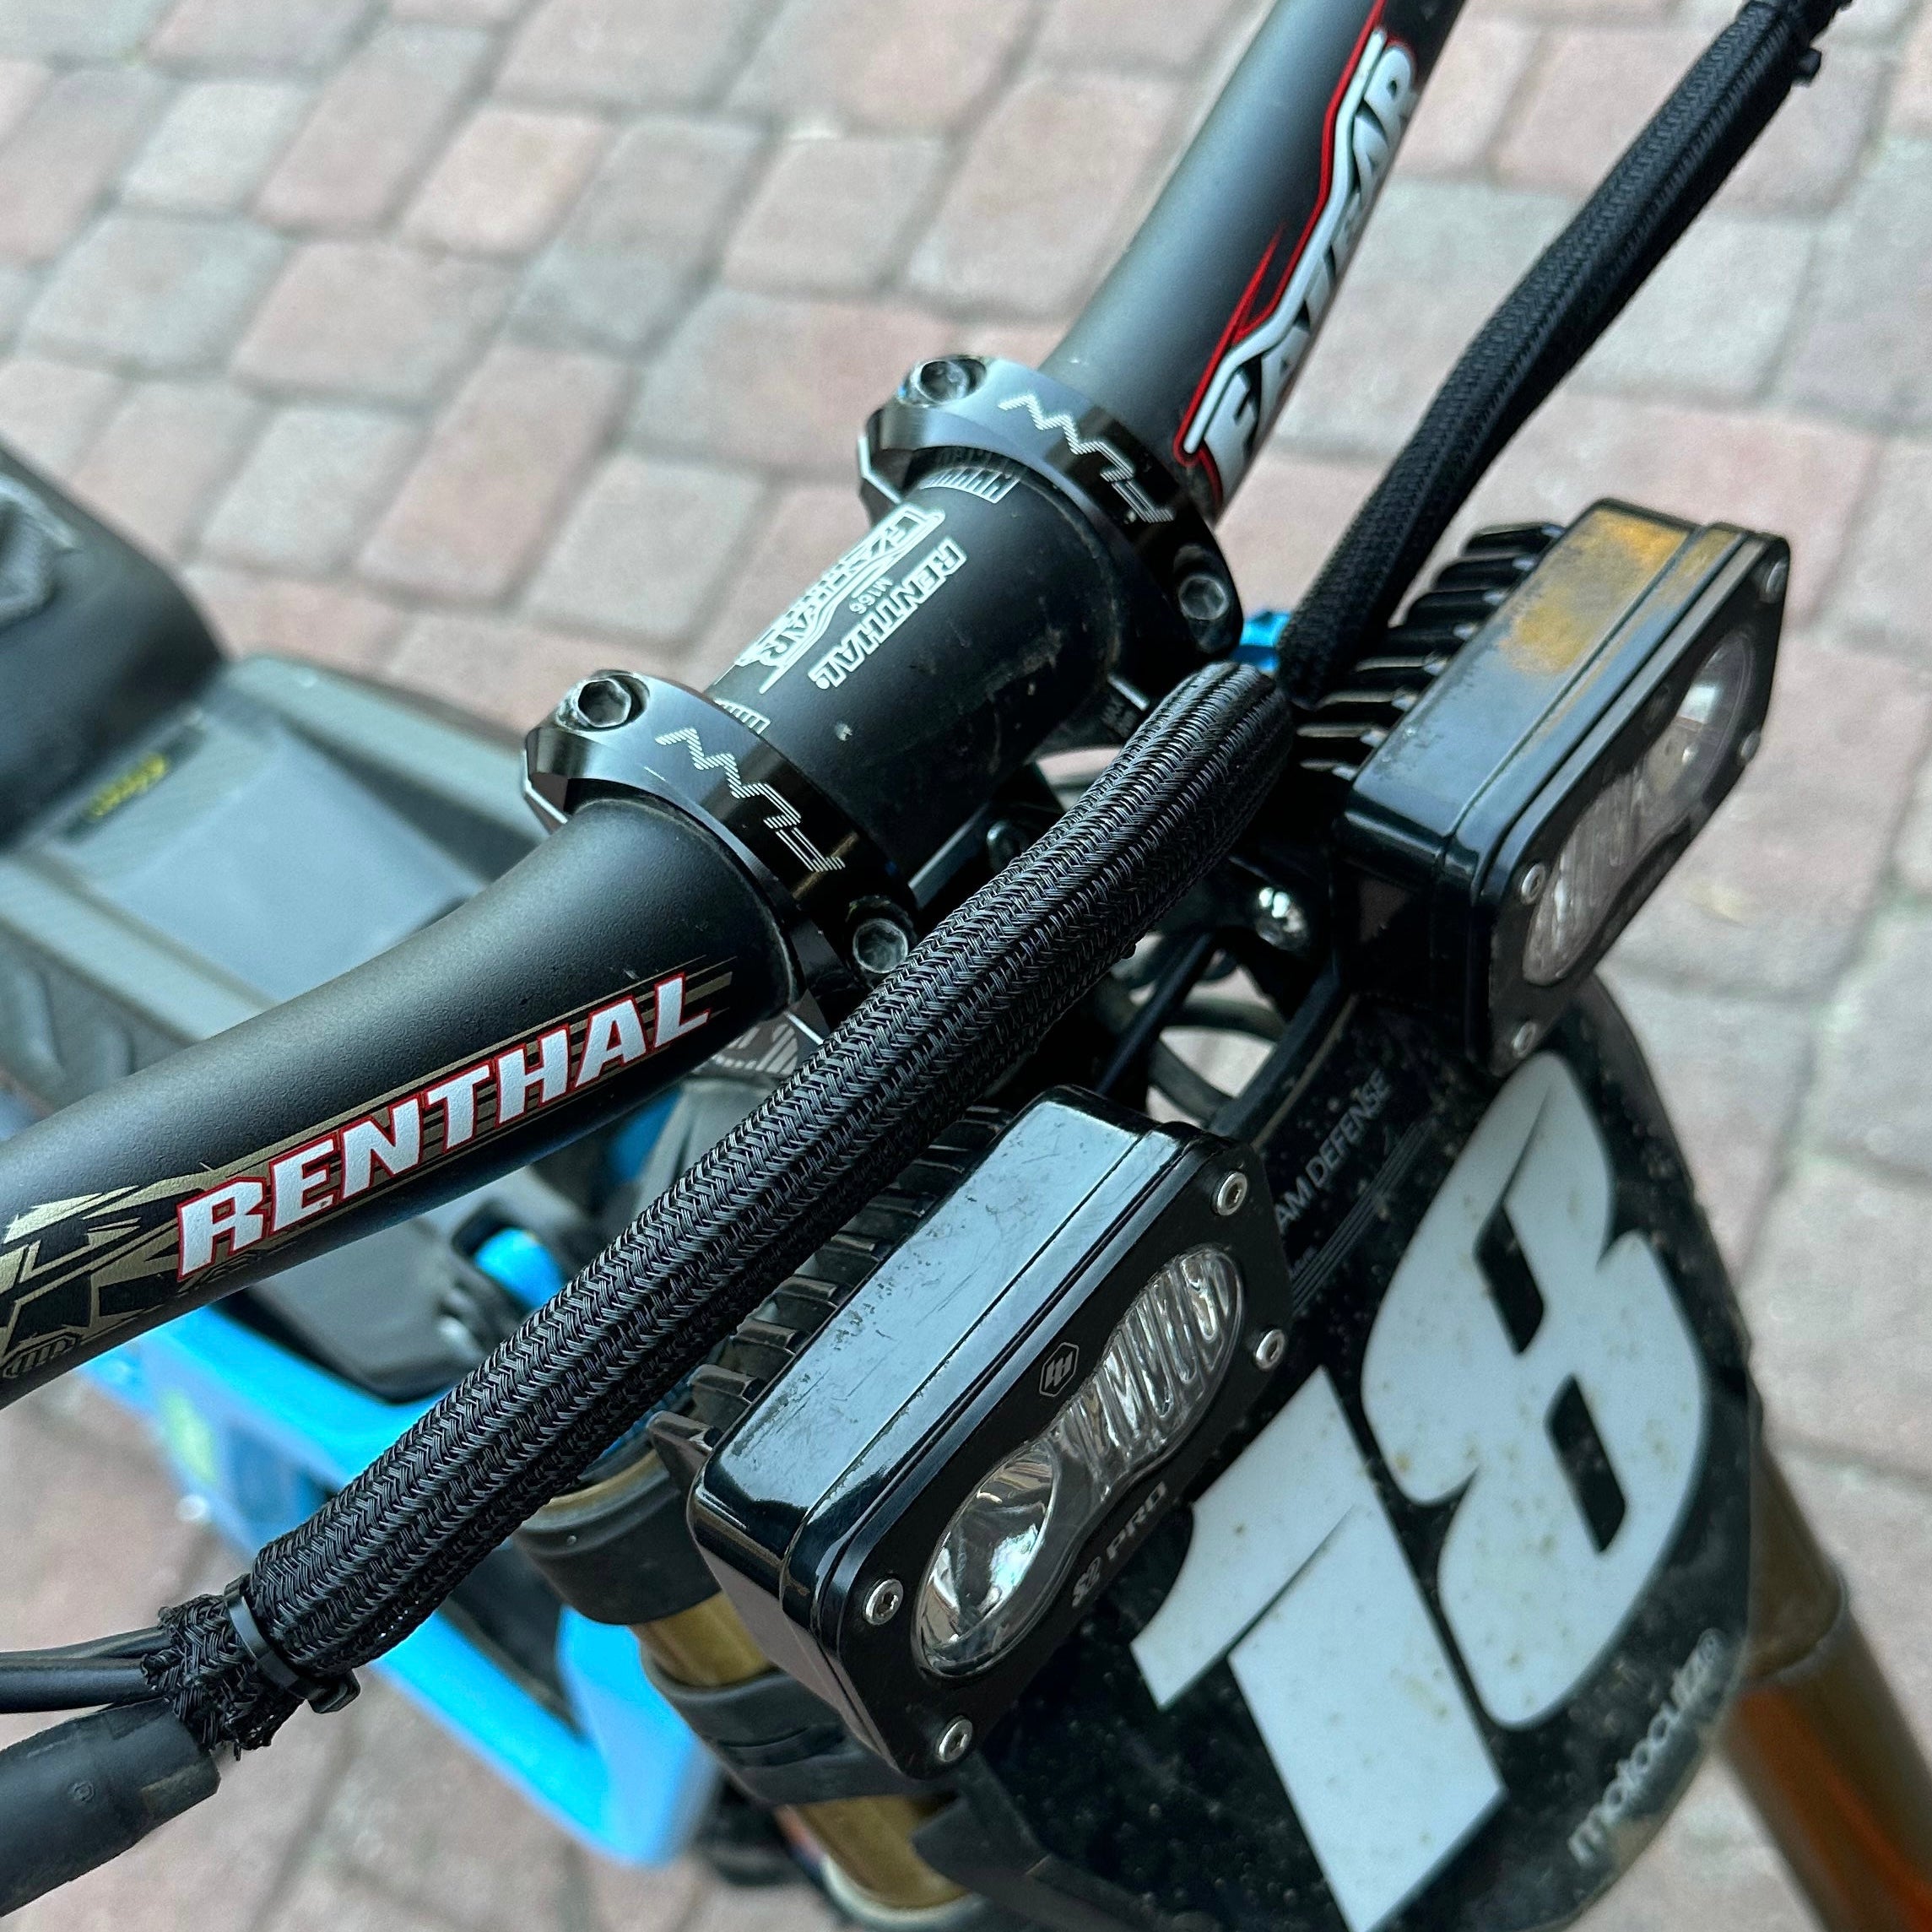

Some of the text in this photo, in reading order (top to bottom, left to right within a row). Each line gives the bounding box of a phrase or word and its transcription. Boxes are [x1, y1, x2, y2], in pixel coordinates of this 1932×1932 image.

[808, 535, 968, 681] RENTHAL
[848, 576, 894, 614] M166
[177, 972, 711, 1281] RENTHAL
[1305, 1067, 1391, 1189] DEFENSE
[1106, 1480, 1167, 1561] PRO
[1130, 1052, 1703, 1932] 18
